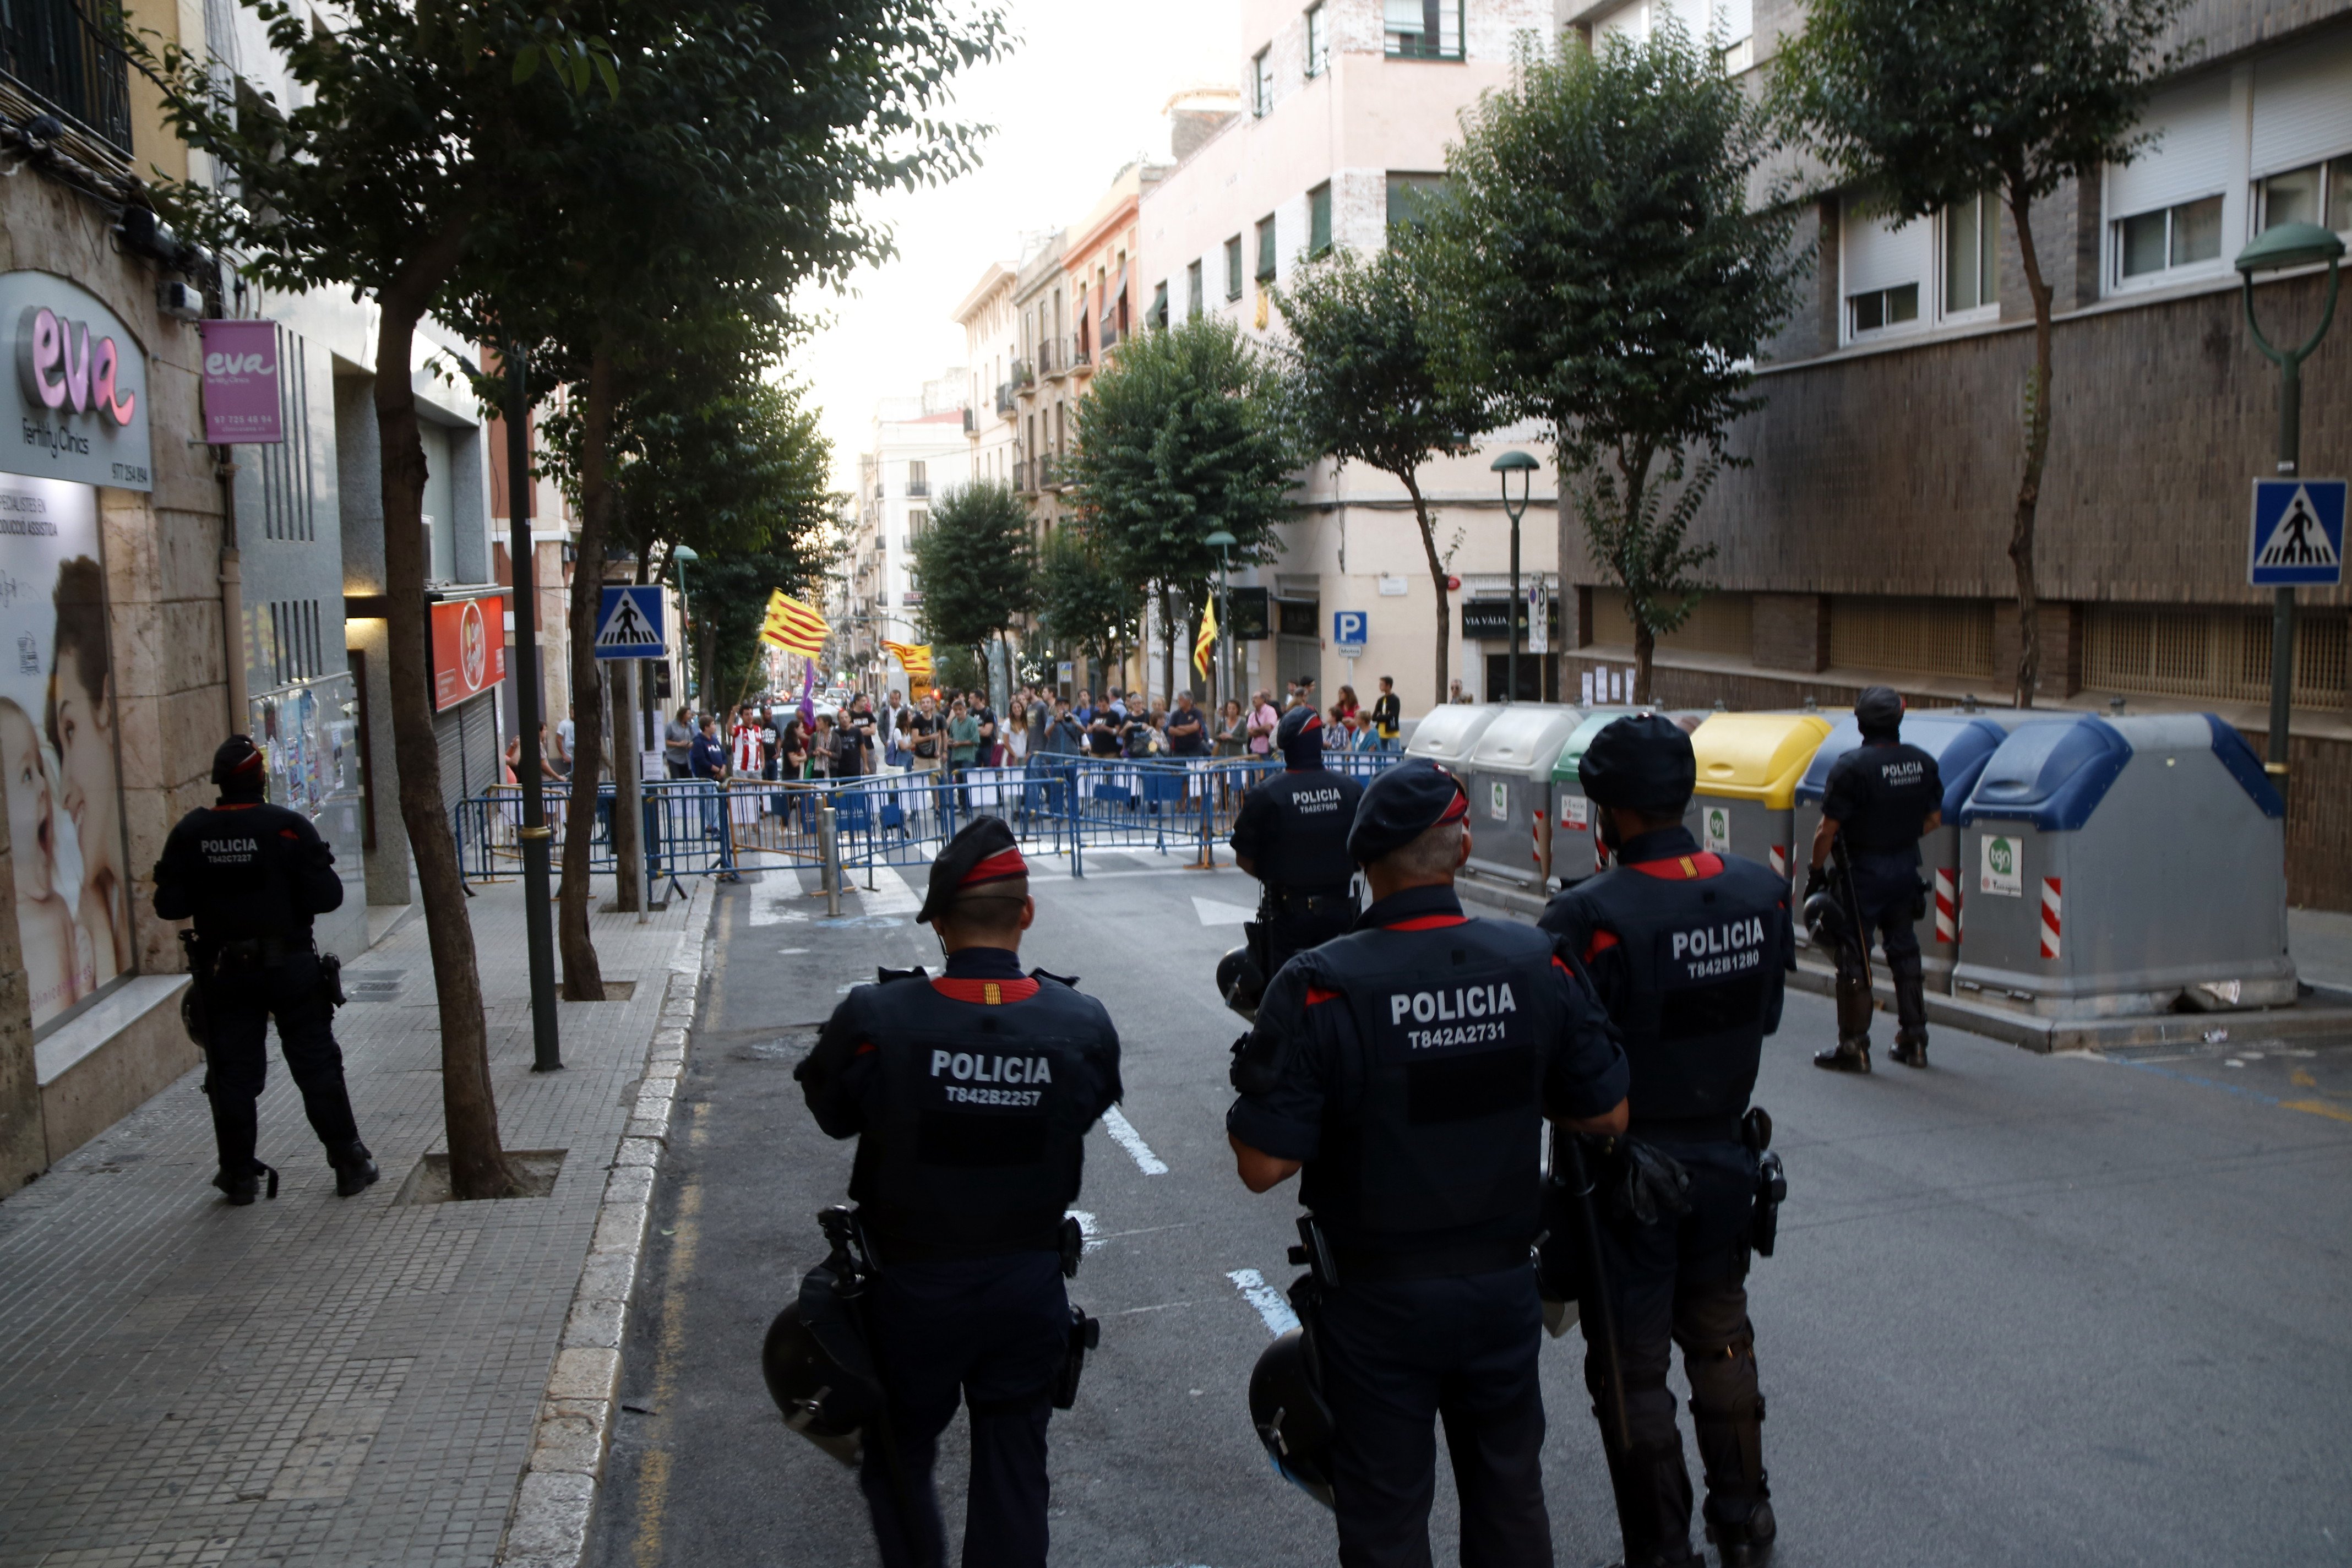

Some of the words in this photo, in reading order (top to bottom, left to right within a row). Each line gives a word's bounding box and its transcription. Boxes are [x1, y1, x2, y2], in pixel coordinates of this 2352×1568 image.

[31, 307, 135, 426] eva
[205, 352, 275, 375] eva
[261, 415, 272, 423] 94
[58, 424, 89, 455] Clinics
[112, 462, 124, 480] 977
[124, 464, 135, 482] 254
[137, 466, 148, 483] 894
[28, 520, 58, 536] ASSISTIDA
[1340, 614, 1360, 641] P
[1465, 616, 1480, 625] VIA
[1482, 614, 1507, 625] VÀLIA
[1882, 761, 1923, 778] POLICIA
[1292, 787, 1341, 805] POLICIA
[1711, 816, 1724, 837] tgn
[201, 838, 258, 853] POLICIA
[207, 854, 252, 863] T842C7227
[1991, 846, 2010, 872] tgn
[1673, 915, 1765, 960] POLICIA
[1687, 948, 1759, 979] T842B1280
[1391, 982, 1516, 1025] POLICIA
[1408, 1020, 1505, 1049] T842A2731
[930, 1049, 1052, 1084] POLICIA
[944, 1085, 1042, 1107] T842B2257
